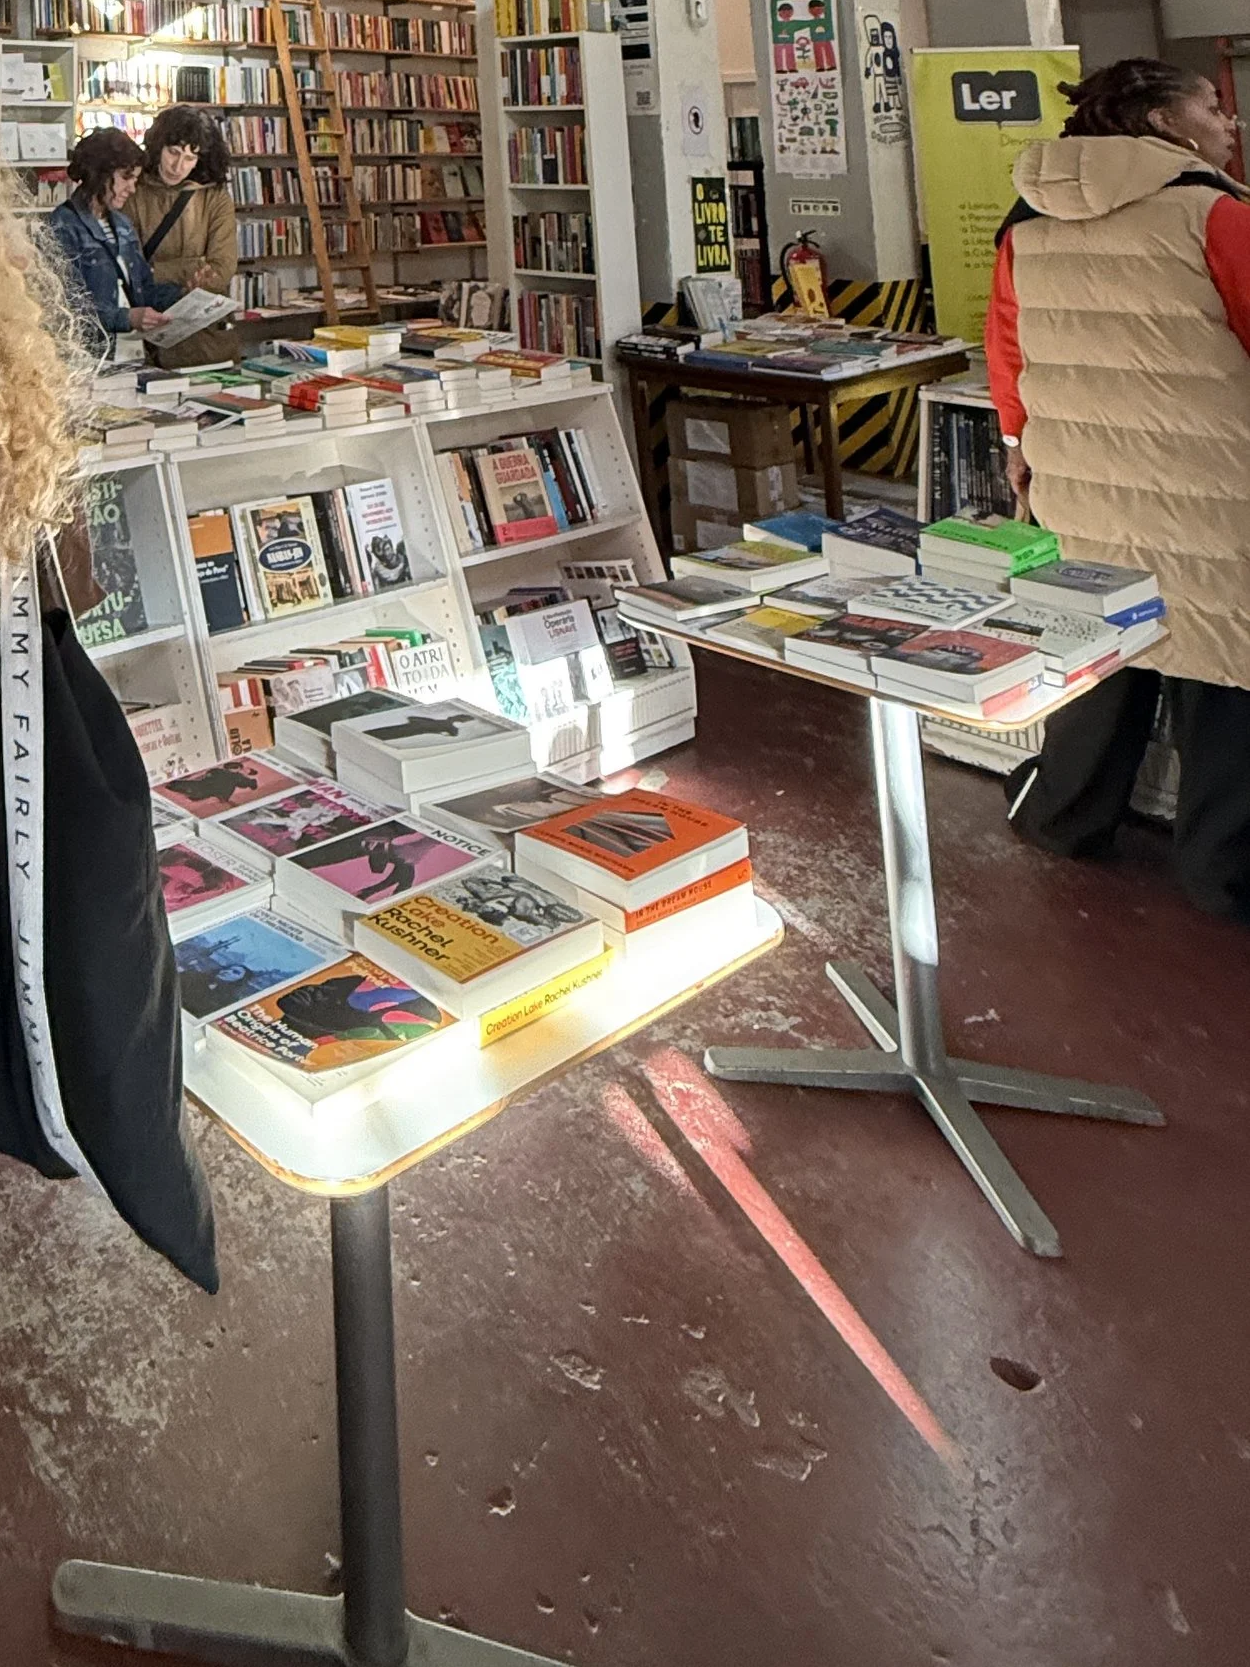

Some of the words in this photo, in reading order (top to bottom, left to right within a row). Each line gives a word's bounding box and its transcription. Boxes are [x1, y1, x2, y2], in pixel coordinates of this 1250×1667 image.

[961, 82, 1017, 112] Ler
[693, 201, 727, 225] LIVRO
[708, 225, 726, 242] TE
[696, 245, 729, 267] LIVRA
[498, 453, 530, 470] GUERRA
[11, 574, 30, 688] IMMY
[400, 654, 410, 670] O
[413, 646, 444, 667] ATRI
[402, 669, 422, 685] TO
[13, 713, 31, 880] FAIRLY
[186, 837, 237, 870] CLOSER
[430, 828, 492, 857] NOTICE
[383, 907, 455, 948] Rachel
[398, 901, 446, 929] Lake
[414, 895, 499, 945] Creation
[367, 914, 451, 962] Kushner
[250, 1003, 273, 1024] The
[486, 1010, 523, 1036] Creation
[523, 1000, 543, 1017] Lake
[544, 984, 572, 1006] Rachel
[223, 1014, 276, 1048] Beatrice
[236, 1010, 280, 1040] Origins
[279, 1038, 301, 1048] of
